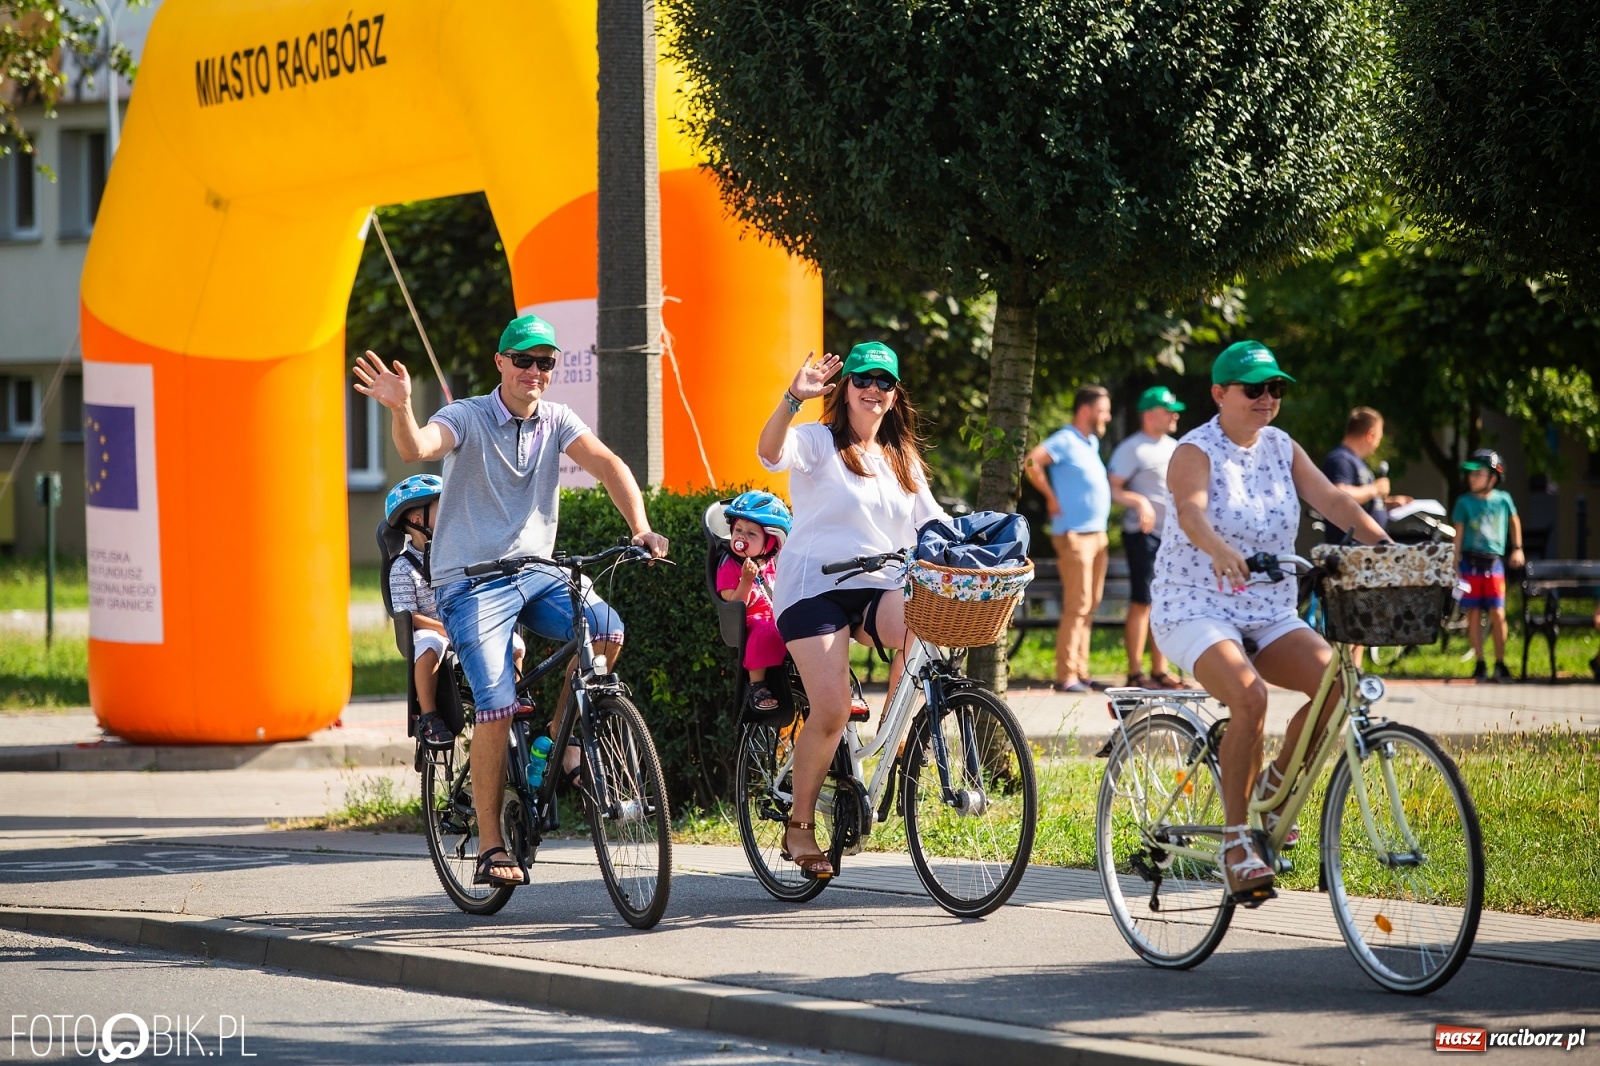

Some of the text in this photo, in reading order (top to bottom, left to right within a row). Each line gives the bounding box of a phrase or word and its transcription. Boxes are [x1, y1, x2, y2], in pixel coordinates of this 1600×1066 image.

[196, 10, 387, 108] MIASTO RACIBÓRZ
[563, 350, 581, 367] Cel
[584, 349, 592, 367] 3
[107, 598, 155, 613] GRANICE
